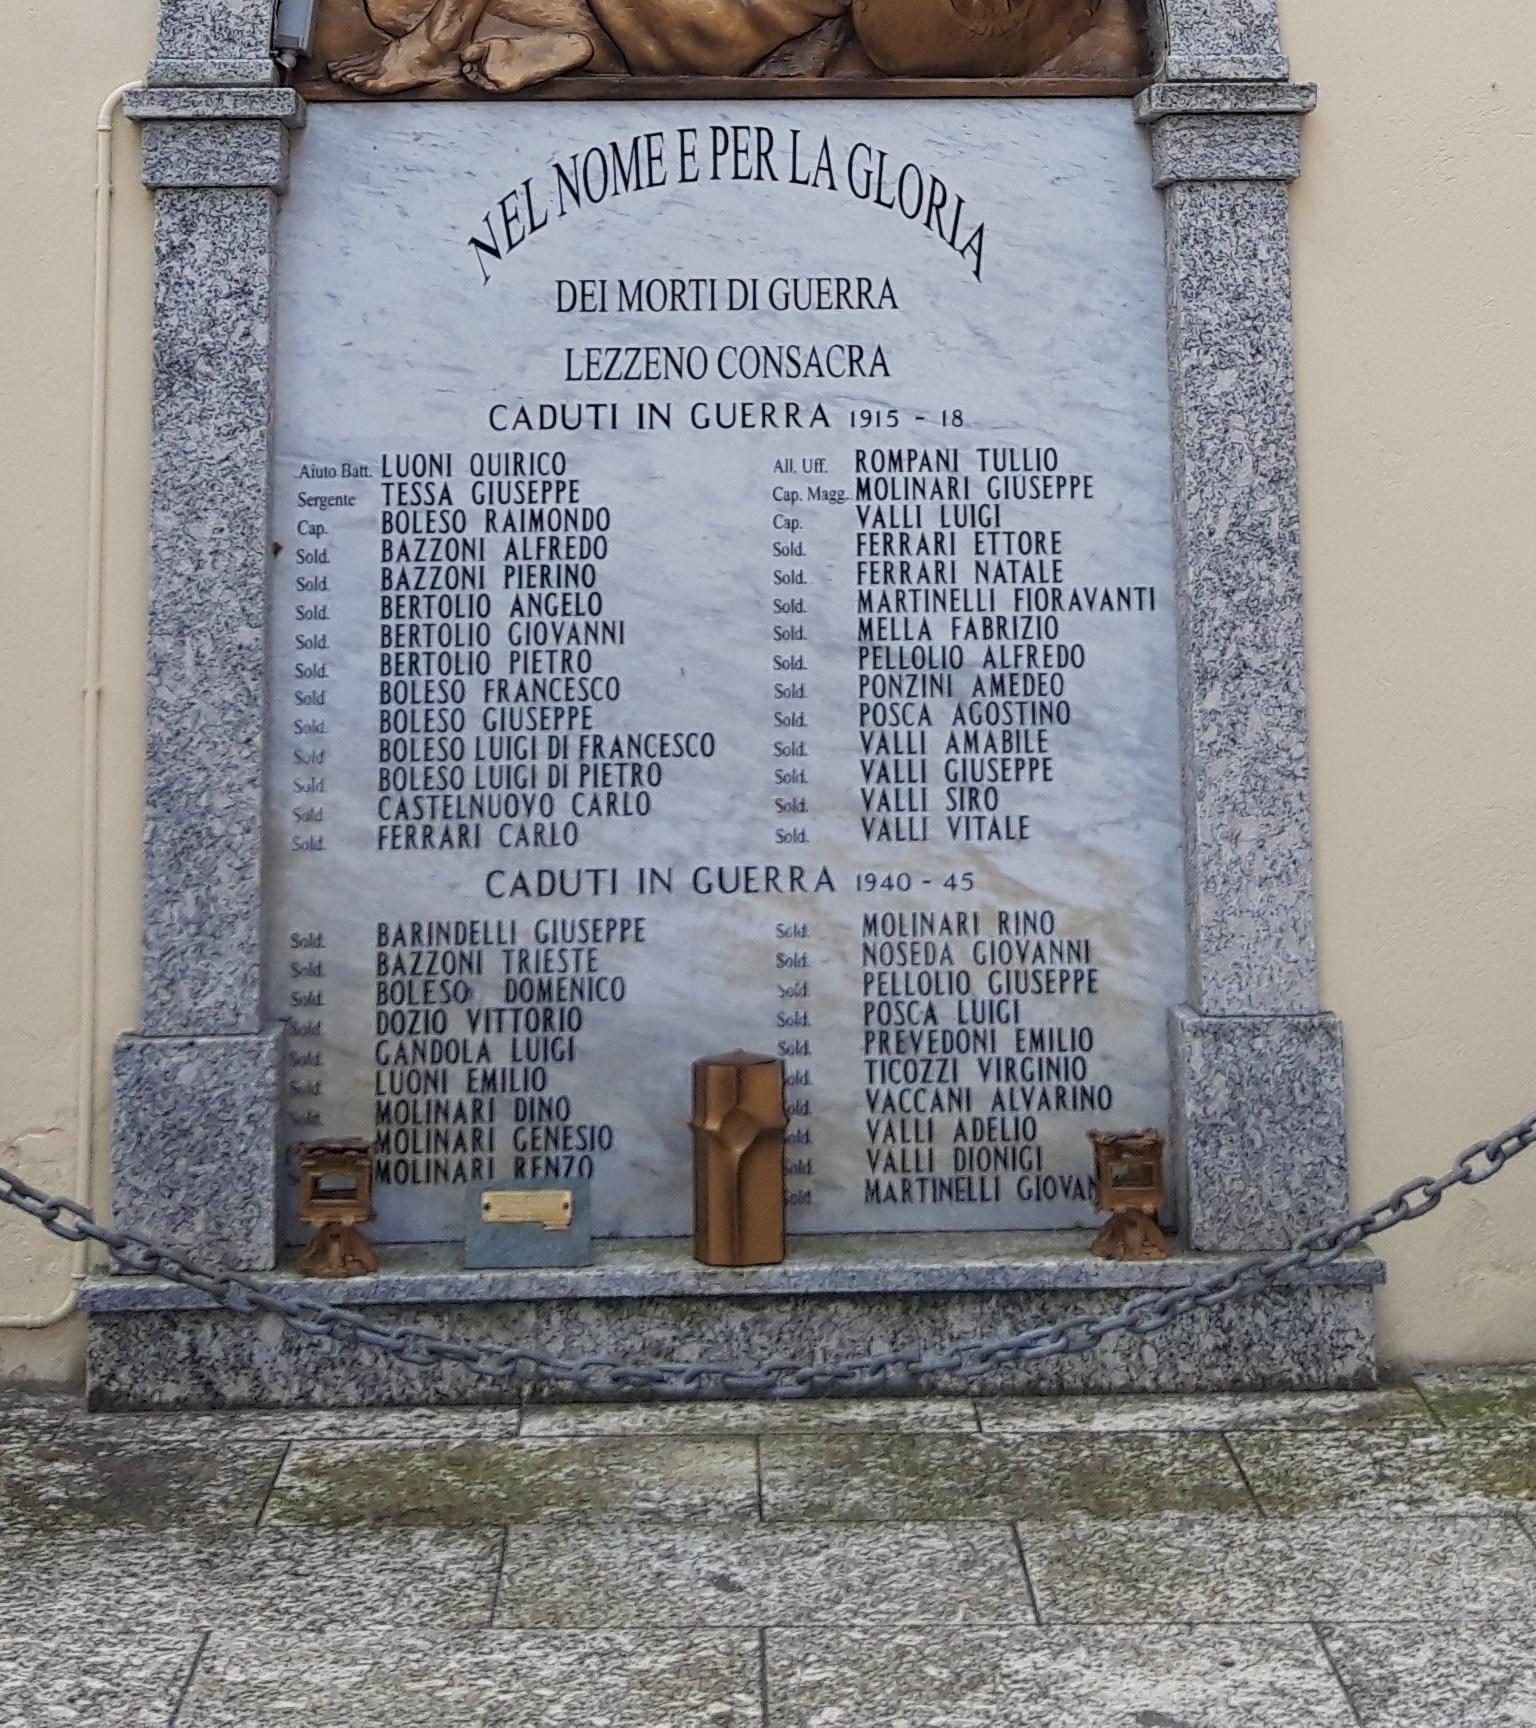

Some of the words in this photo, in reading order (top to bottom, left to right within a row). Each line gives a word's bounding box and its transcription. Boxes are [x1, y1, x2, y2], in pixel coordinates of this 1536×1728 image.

[467, 177, 549, 285] NEL
[552, 132, 666, 217] NOME
[678, 128, 699, 184] E
[710, 125, 776, 182] PER
[789, 129, 837, 191] LA
[847, 142, 987, 282] GLORIA
[556, 280, 607, 312] DEI
[617, 279, 716, 312] MORTI
[728, 278, 759, 311] DI
[769, 277, 899, 311] GUERRA
[565, 347, 707, 382] LEZZENO
[717, 344, 891, 380] CONSACRA
[489, 403, 617, 430] CADUTI
[638, 403, 670, 429] IN
[691, 402, 830, 430] GUERRA
[850, 409, 899, 429] 1915
[941, 408, 963, 427] 18
[382, 453, 452, 477] LUONI
[470, 452, 566, 477] QUIRICO
[774, 458, 796, 474] All.
[802, 458, 828, 474] Uff.
[855, 449, 959, 473] ROMPANI
[976, 447, 1058, 472] TULLIO
[298, 492, 356, 509] Sergente
[382, 482, 452, 506] TESSA
[472, 480, 580, 505] GIUSEPPE
[773, 486, 802, 503] Cap.
[855, 477, 969, 501] MOLINARI
[988, 476, 1094, 499] GIUSEPPE
[298, 521, 327, 536] Cap.
[382, 510, 466, 534] BOLESO
[485, 508, 610, 532] RAIMONDO
[773, 515, 802, 531] Cap.
[857, 505, 922, 529] VALLI
[940, 504, 1001, 528] LUIGI
[296, 549, 329, 564] Sold.
[382, 538, 485, 563] BAZZONI
[504, 536, 608, 560] ALFREDO
[773, 542, 806, 557] Sold.
[857, 533, 957, 557] FERRARI
[974, 531, 1062, 555] ETTORE
[381, 567, 485, 591] BAZZONI
[504, 565, 596, 589] PIERINO
[773, 570, 807, 585] Sold.
[857, 561, 957, 585] FERRARI
[975, 560, 1063, 583] NATALE
[295, 606, 329, 620] Sold.
[381, 595, 491, 619] BERTOLIO
[510, 592, 602, 617] ANGELO
[773, 599, 807, 613] Sold.
[858, 588, 995, 613] MARTINELLI
[1014, 586, 1155, 612] FIORAVANTI
[381, 624, 491, 648] BERTOLIO
[509, 620, 624, 646] GIOVANNI
[773, 626, 807, 641] Sold.
[858, 617, 932, 641] MELLA
[952, 616, 1058, 640] FABRIZIO
[380, 652, 491, 677] BERTOLIO
[510, 650, 591, 674] PIETRO
[773, 656, 807, 670] Sold.
[858, 645, 963, 670] PELLOLIO
[983, 644, 1085, 669] ALFREDO
[380, 680, 465, 705] BOLESO
[484, 677, 620, 702] FRANCESCO
[859, 674, 953, 699] PONZINI
[972, 673, 1064, 697] AMEDEO
[380, 709, 465, 733] BOLESO
[483, 706, 593, 731] GIUSEPPE
[859, 703, 932, 727] POSCA
[952, 701, 1071, 726] AGOSTINO
[379, 738, 465, 762] BOLESO
[475, 736, 537, 761] LUIGI
[548, 735, 568, 759] DI
[579, 733, 715, 758] FRANCESCO
[859, 731, 926, 755] VALLI
[945, 730, 1048, 754] AMABILE
[379, 767, 464, 792] BOLESO
[475, 765, 537, 790] LUIGI
[548, 764, 568, 788] DI
[579, 762, 662, 788] PIETRO
[860, 760, 927, 784] VALLI
[945, 758, 1053, 783] GIUSEPPE
[378, 793, 553, 820] CASTELNUOVO
[572, 792, 651, 817] CARLO
[861, 788, 927, 813] VALLI
[945, 787, 999, 811] SIRO
[378, 824, 481, 850] FERRARI
[499, 822, 579, 847] CARLO
[775, 828, 809, 843] Sold.
[861, 817, 928, 842] VALLI
[947, 816, 1030, 841] VITALE
[486, 869, 617, 898] CADUTI
[639, 868, 672, 894] IN
[692, 866, 835, 895] GUERRA
[856, 873, 911, 893] 1940
[943, 872, 974, 892] 45
[377, 921, 516, 947] BARINDELLI
[535, 918, 645, 944] GIUSEPPE
[863, 912, 979, 937] MOLINARI
[998, 911, 1055, 936] RINO
[377, 950, 482, 977] BAZZONI
[503, 948, 599, 973] TRIESTE
[863, 941, 954, 967] NOSEDA
[973, 939, 1091, 965] GIOVANNI
[377, 979, 467, 1006] BOLESO
[505, 976, 625, 1003] DOMENICO
[864, 971, 971, 996] PELLOLIO
[988, 969, 1098, 994] GIUSEPPE
[376, 1010, 447, 1035] DOZIO
[467, 1007, 583, 1033] VITTORIO
[864, 1001, 936, 1026] POSCA
[958, 1000, 1020, 1024] LUIGI
[376, 1039, 491, 1066] GANDOLA
[511, 1037, 575, 1062] LUIGI
[864, 1029, 996, 1055] PREVEDONI
[1016, 1027, 1093, 1052] EMILIO
[376, 1070, 447, 1096] LUONI
[467, 1067, 546, 1093] EMILIO
[865, 1059, 958, 1085] TICOZZI
[977, 1057, 1086, 1082] VIRGINIO
[376, 1099, 494, 1126] MOLINARI
[515, 1096, 570, 1122] DINO
[866, 1088, 972, 1114] VACCANI
[992, 1086, 1113, 1112] ALVARINO
[376, 1128, 494, 1155] MOLINARI
[514, 1125, 612, 1151] GENESIO
[867, 1119, 933, 1144] VALLI
[954, 1117, 1037, 1143] ADELIO
[376, 1157, 493, 1185] MOLINARI
[867, 1148, 933, 1173] VALLI
[954, 1147, 1042, 1172] DIONIGI
[864, 1177, 1000, 1204] MARTINELLI
[1017, 1176, 1099, 1202] GIOVAN
